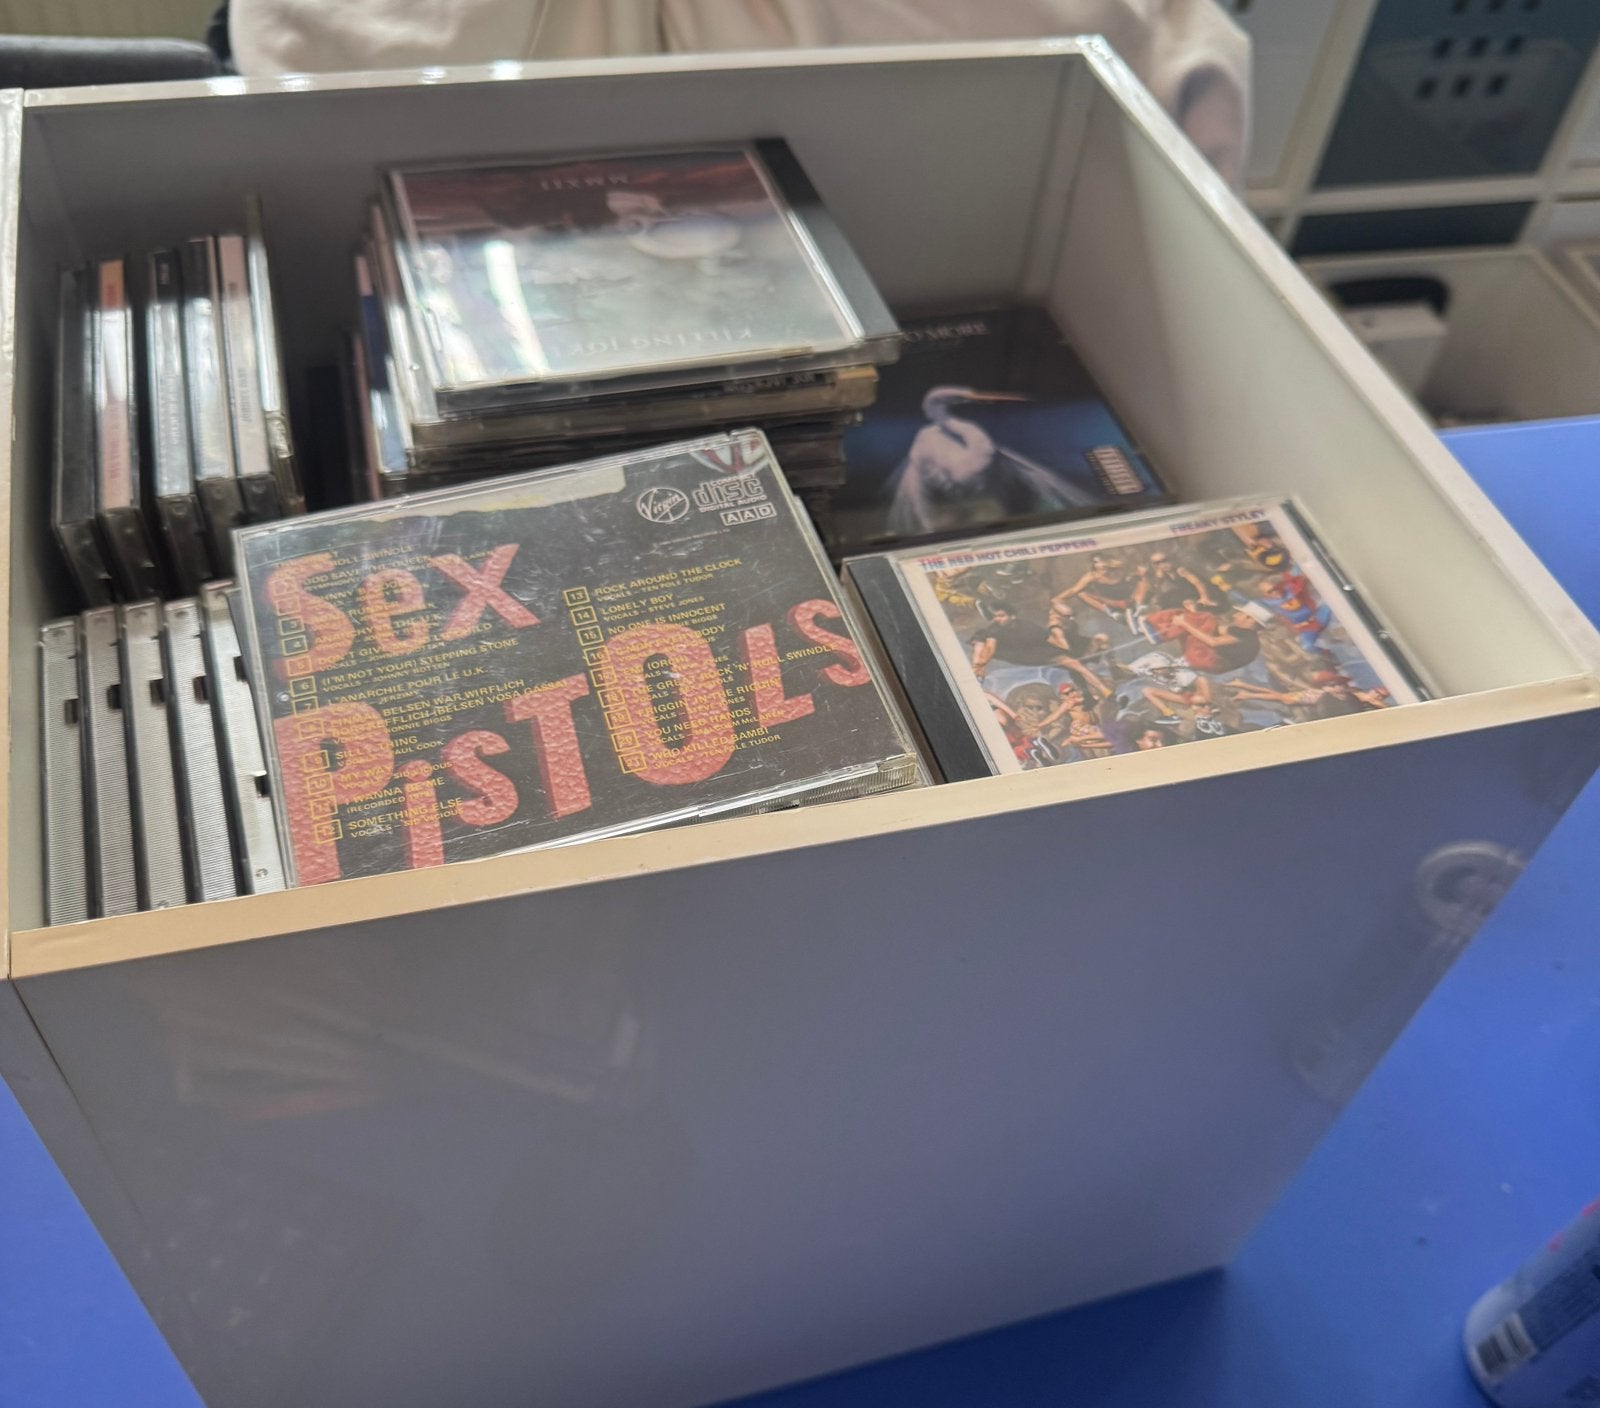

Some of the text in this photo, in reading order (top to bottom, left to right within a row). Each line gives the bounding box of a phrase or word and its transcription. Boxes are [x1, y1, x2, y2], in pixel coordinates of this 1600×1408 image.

[639, 488, 684, 522] Virgin
[917, 537, 1098, 569] THE RED HOT CHILI PEPPERS
[594, 583, 628, 598] ROCK
[629, 571, 678, 590] AROUND
[680, 566, 703, 578] THE
[703, 558, 743, 573] CLOCK
[640, 584, 660, 594] TEN
[683, 572, 715, 585] TUDOR
[600, 599, 648, 616] LONELY
[649, 592, 675, 606] BOY
[602, 595, 706, 623] VOCALS STEVE JONES
[606, 624, 627, 637] NO
[627, 619, 654, 633] ONE
[654, 615, 668, 626] IS
[668, 601, 727, 623] INNOCENT
[347, 667, 374, 681] NOT
[419, 646, 478, 666] STEPPING
[479, 637, 520, 654] STONE
[785, 642, 841, 661] SWINDLE
[321, 680, 362, 693] VOCALS
[407, 675, 442, 690] POUR
[445, 671, 461, 682] LE
[382, 699, 432, 718] BELSEN
[464, 678, 526, 700] WIRFLICH
[486, 690, 522, 704] VOSA
[423, 714, 454, 727] BIGGS
[646, 725, 672, 740] YOU
[673, 718, 707, 733] NEED
[709, 706, 752, 724] HANDS
[415, 738, 446, 752] COOK
[651, 746, 681, 762] WHO
[683, 735, 729, 753] KILLED
[731, 726, 770, 743] BAMBI
[748, 733, 782, 748] TUDOR
[353, 786, 403, 805] WANNA
[426, 776, 446, 790] ME
[348, 806, 429, 831] SOMETHING
[432, 797, 465, 811] ELSE
[350, 823, 393, 839] VOCALS
